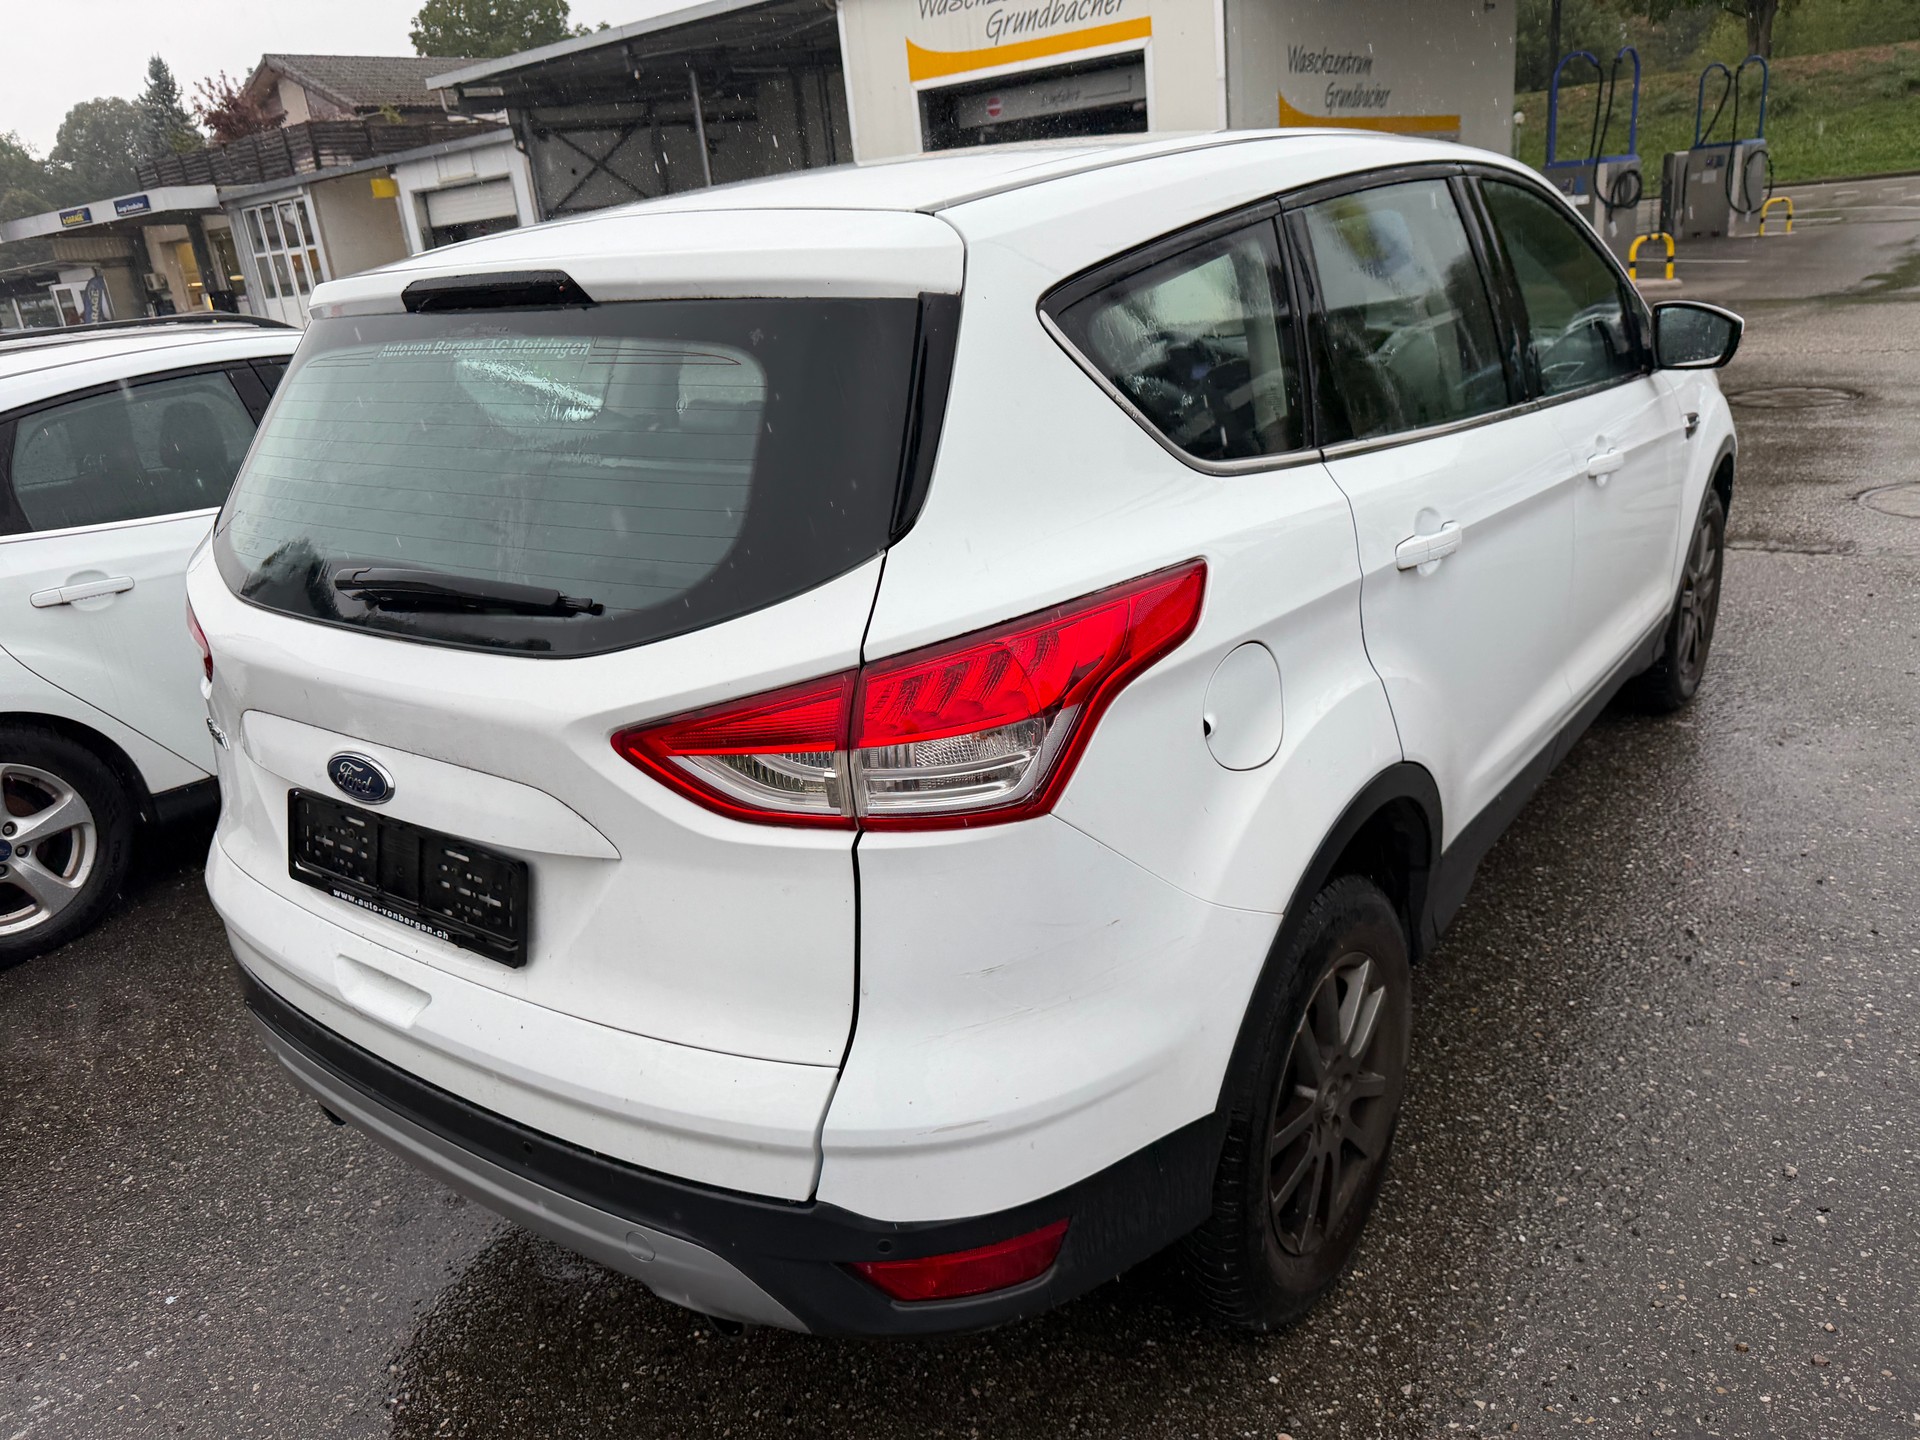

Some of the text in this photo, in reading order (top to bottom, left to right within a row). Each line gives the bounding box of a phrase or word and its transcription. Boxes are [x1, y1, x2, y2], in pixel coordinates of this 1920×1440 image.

[986, 0, 1123, 46] Grundbacher
[431, 340, 482, 358] Bergen
[483, 339, 509, 354] AG
[509, 338, 591, 359] Meiringen
[336, 761, 372, 794] Ford
[333, 888, 449, 940] www.auto-vonbergen.ch
